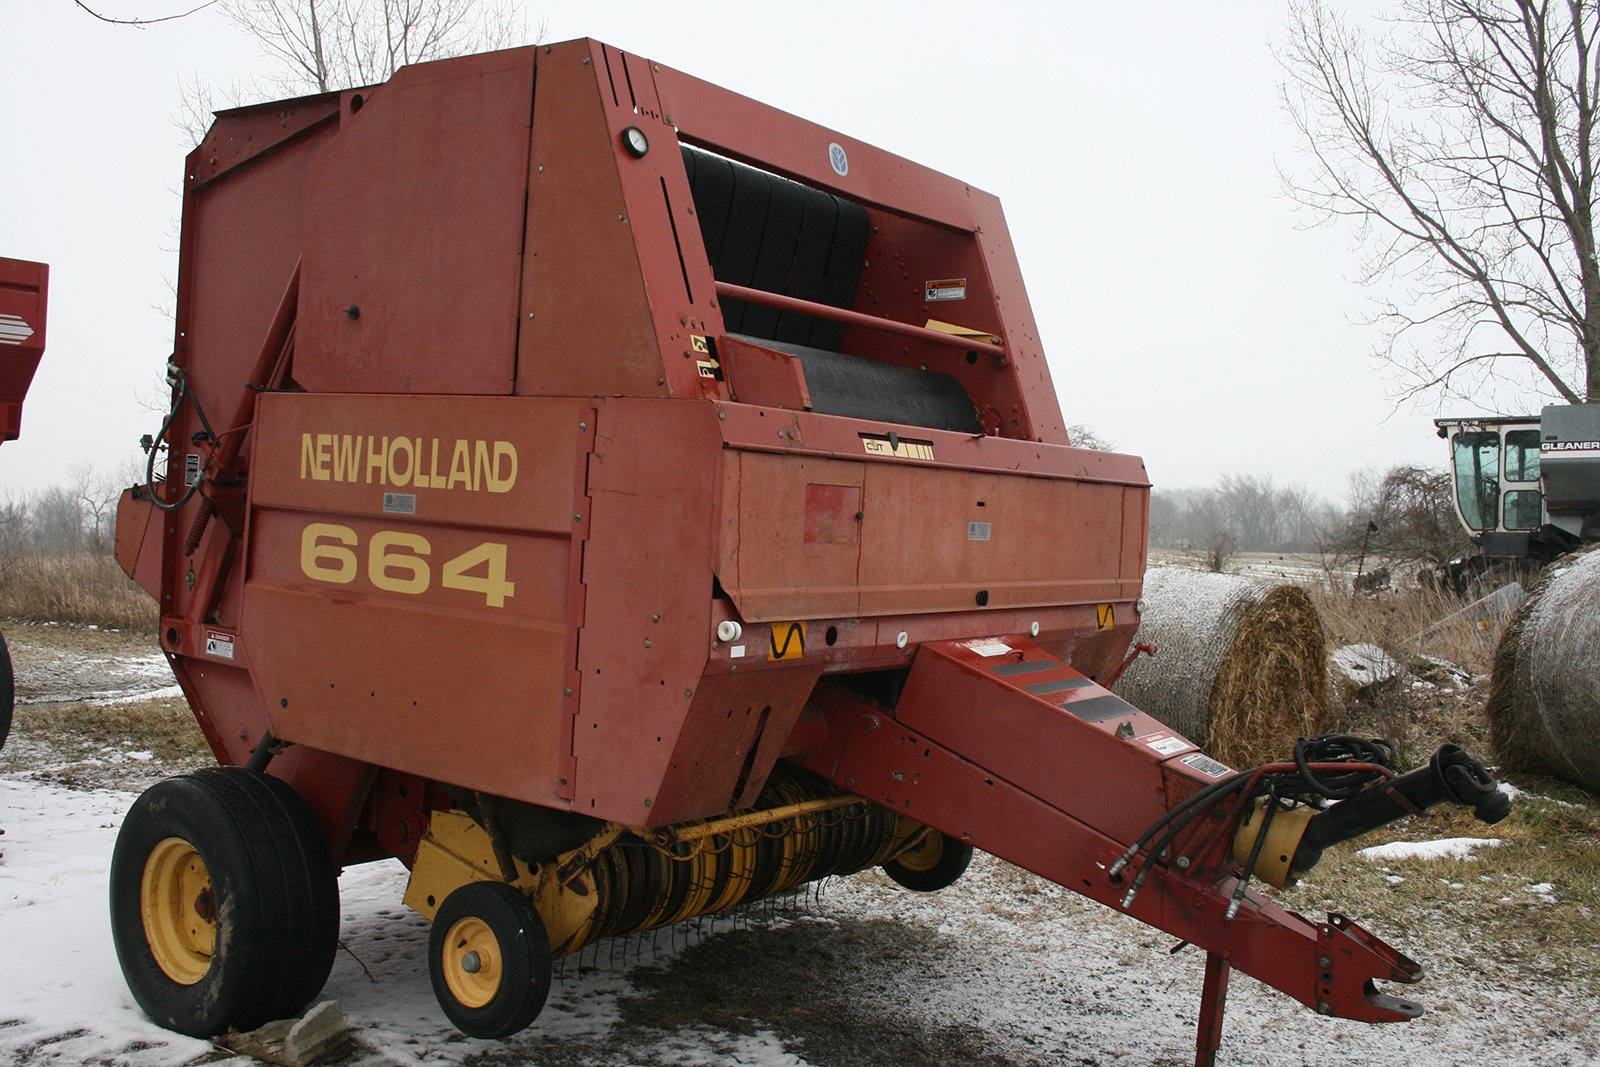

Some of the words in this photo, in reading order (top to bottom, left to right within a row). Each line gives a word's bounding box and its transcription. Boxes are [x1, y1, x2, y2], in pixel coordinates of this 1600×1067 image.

[301, 433, 363, 483] NEW
[366, 436, 518, 493] HOLLAND
[866, 442, 883, 451] CUT
[1541, 442, 1600, 450] GLEANER
[301, 522, 515, 608] 664
